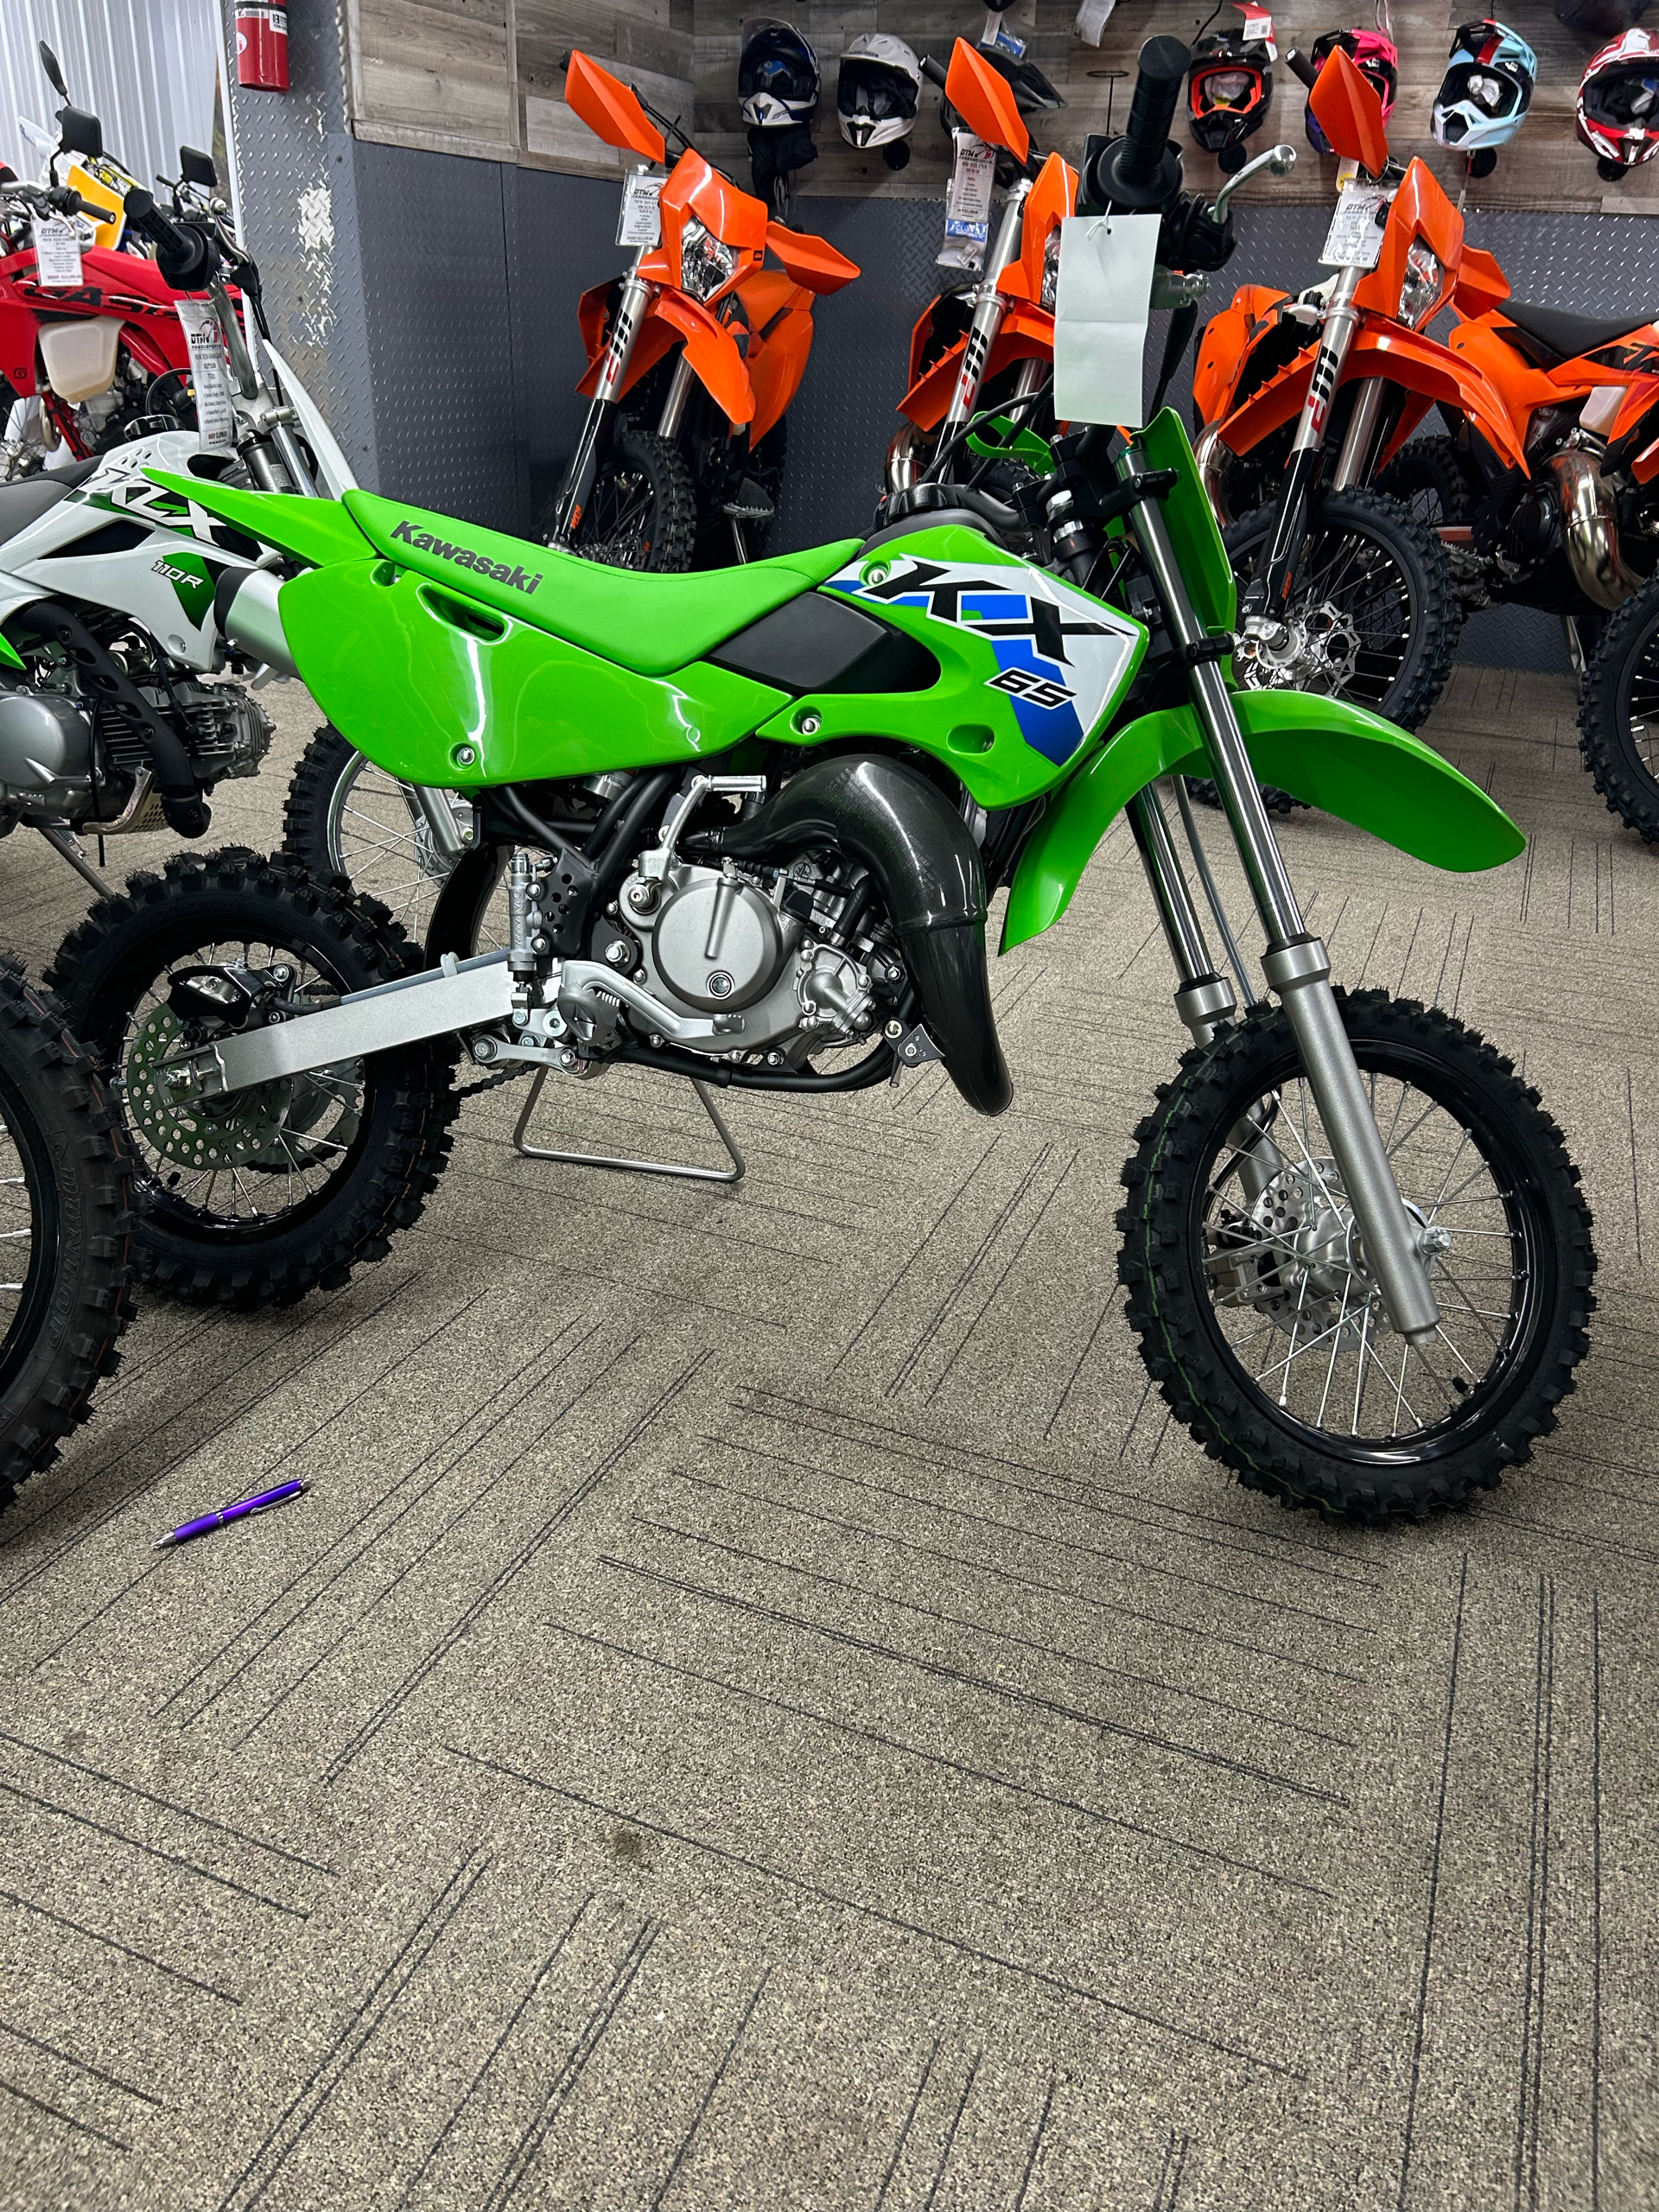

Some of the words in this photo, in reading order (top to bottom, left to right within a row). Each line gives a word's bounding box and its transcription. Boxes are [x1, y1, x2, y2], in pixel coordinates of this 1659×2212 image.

[151, 560, 206, 589] 110R
[391, 520, 544, 594] Kawasaki
[861, 560, 1137, 668] KX
[988, 669, 1078, 708] 65
[49, 1166, 82, 1348] DUNLOP
